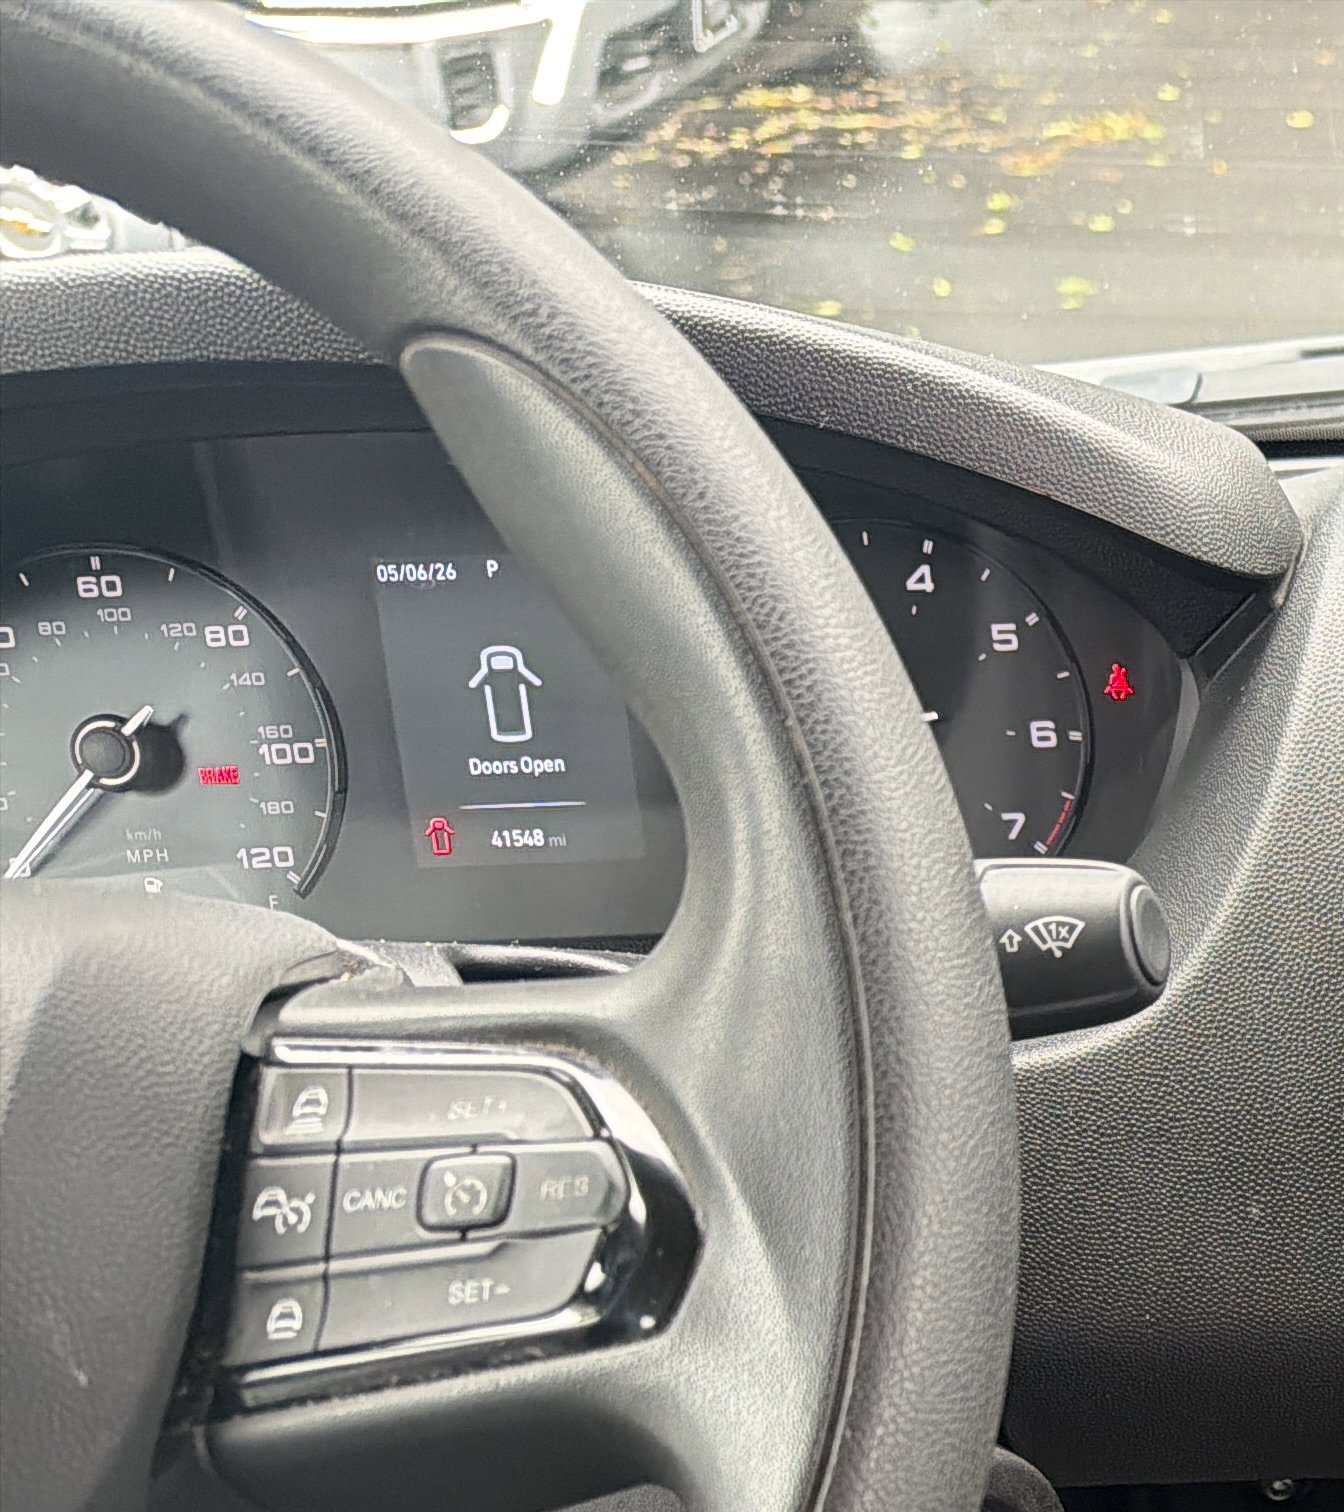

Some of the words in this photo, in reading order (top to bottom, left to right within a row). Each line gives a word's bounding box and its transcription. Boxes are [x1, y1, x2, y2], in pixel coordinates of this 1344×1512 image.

[376, 562, 457, 583] 05/06/26
[486, 559, 499, 578] P
[906, 564, 935, 592] 4
[76, 574, 123, 598] 60
[97, 607, 132, 622] 100
[38, 621, 66, 635] 80
[160, 622, 197, 638] 120
[204, 624, 250, 648] 80
[990, 623, 1020, 652] 5
[230, 672, 266, 687] 140
[257, 725, 293, 739] 160
[1029, 720, 1059, 749] 6
[258, 743, 315, 765] 100
[469, 757, 518, 776] Doors
[520, 755, 566, 776] Open
[259, 801, 294, 815] 180
[126, 829, 162, 842] km/h
[1000, 812, 1026, 841] 7
[491, 828, 545, 848] 41548
[549, 834, 567, 847] mi
[126, 848, 169, 863] MPH
[236, 846, 294, 869] 120
[268, 894, 279, 911] F
[342, 1187, 407, 1214] CANC
